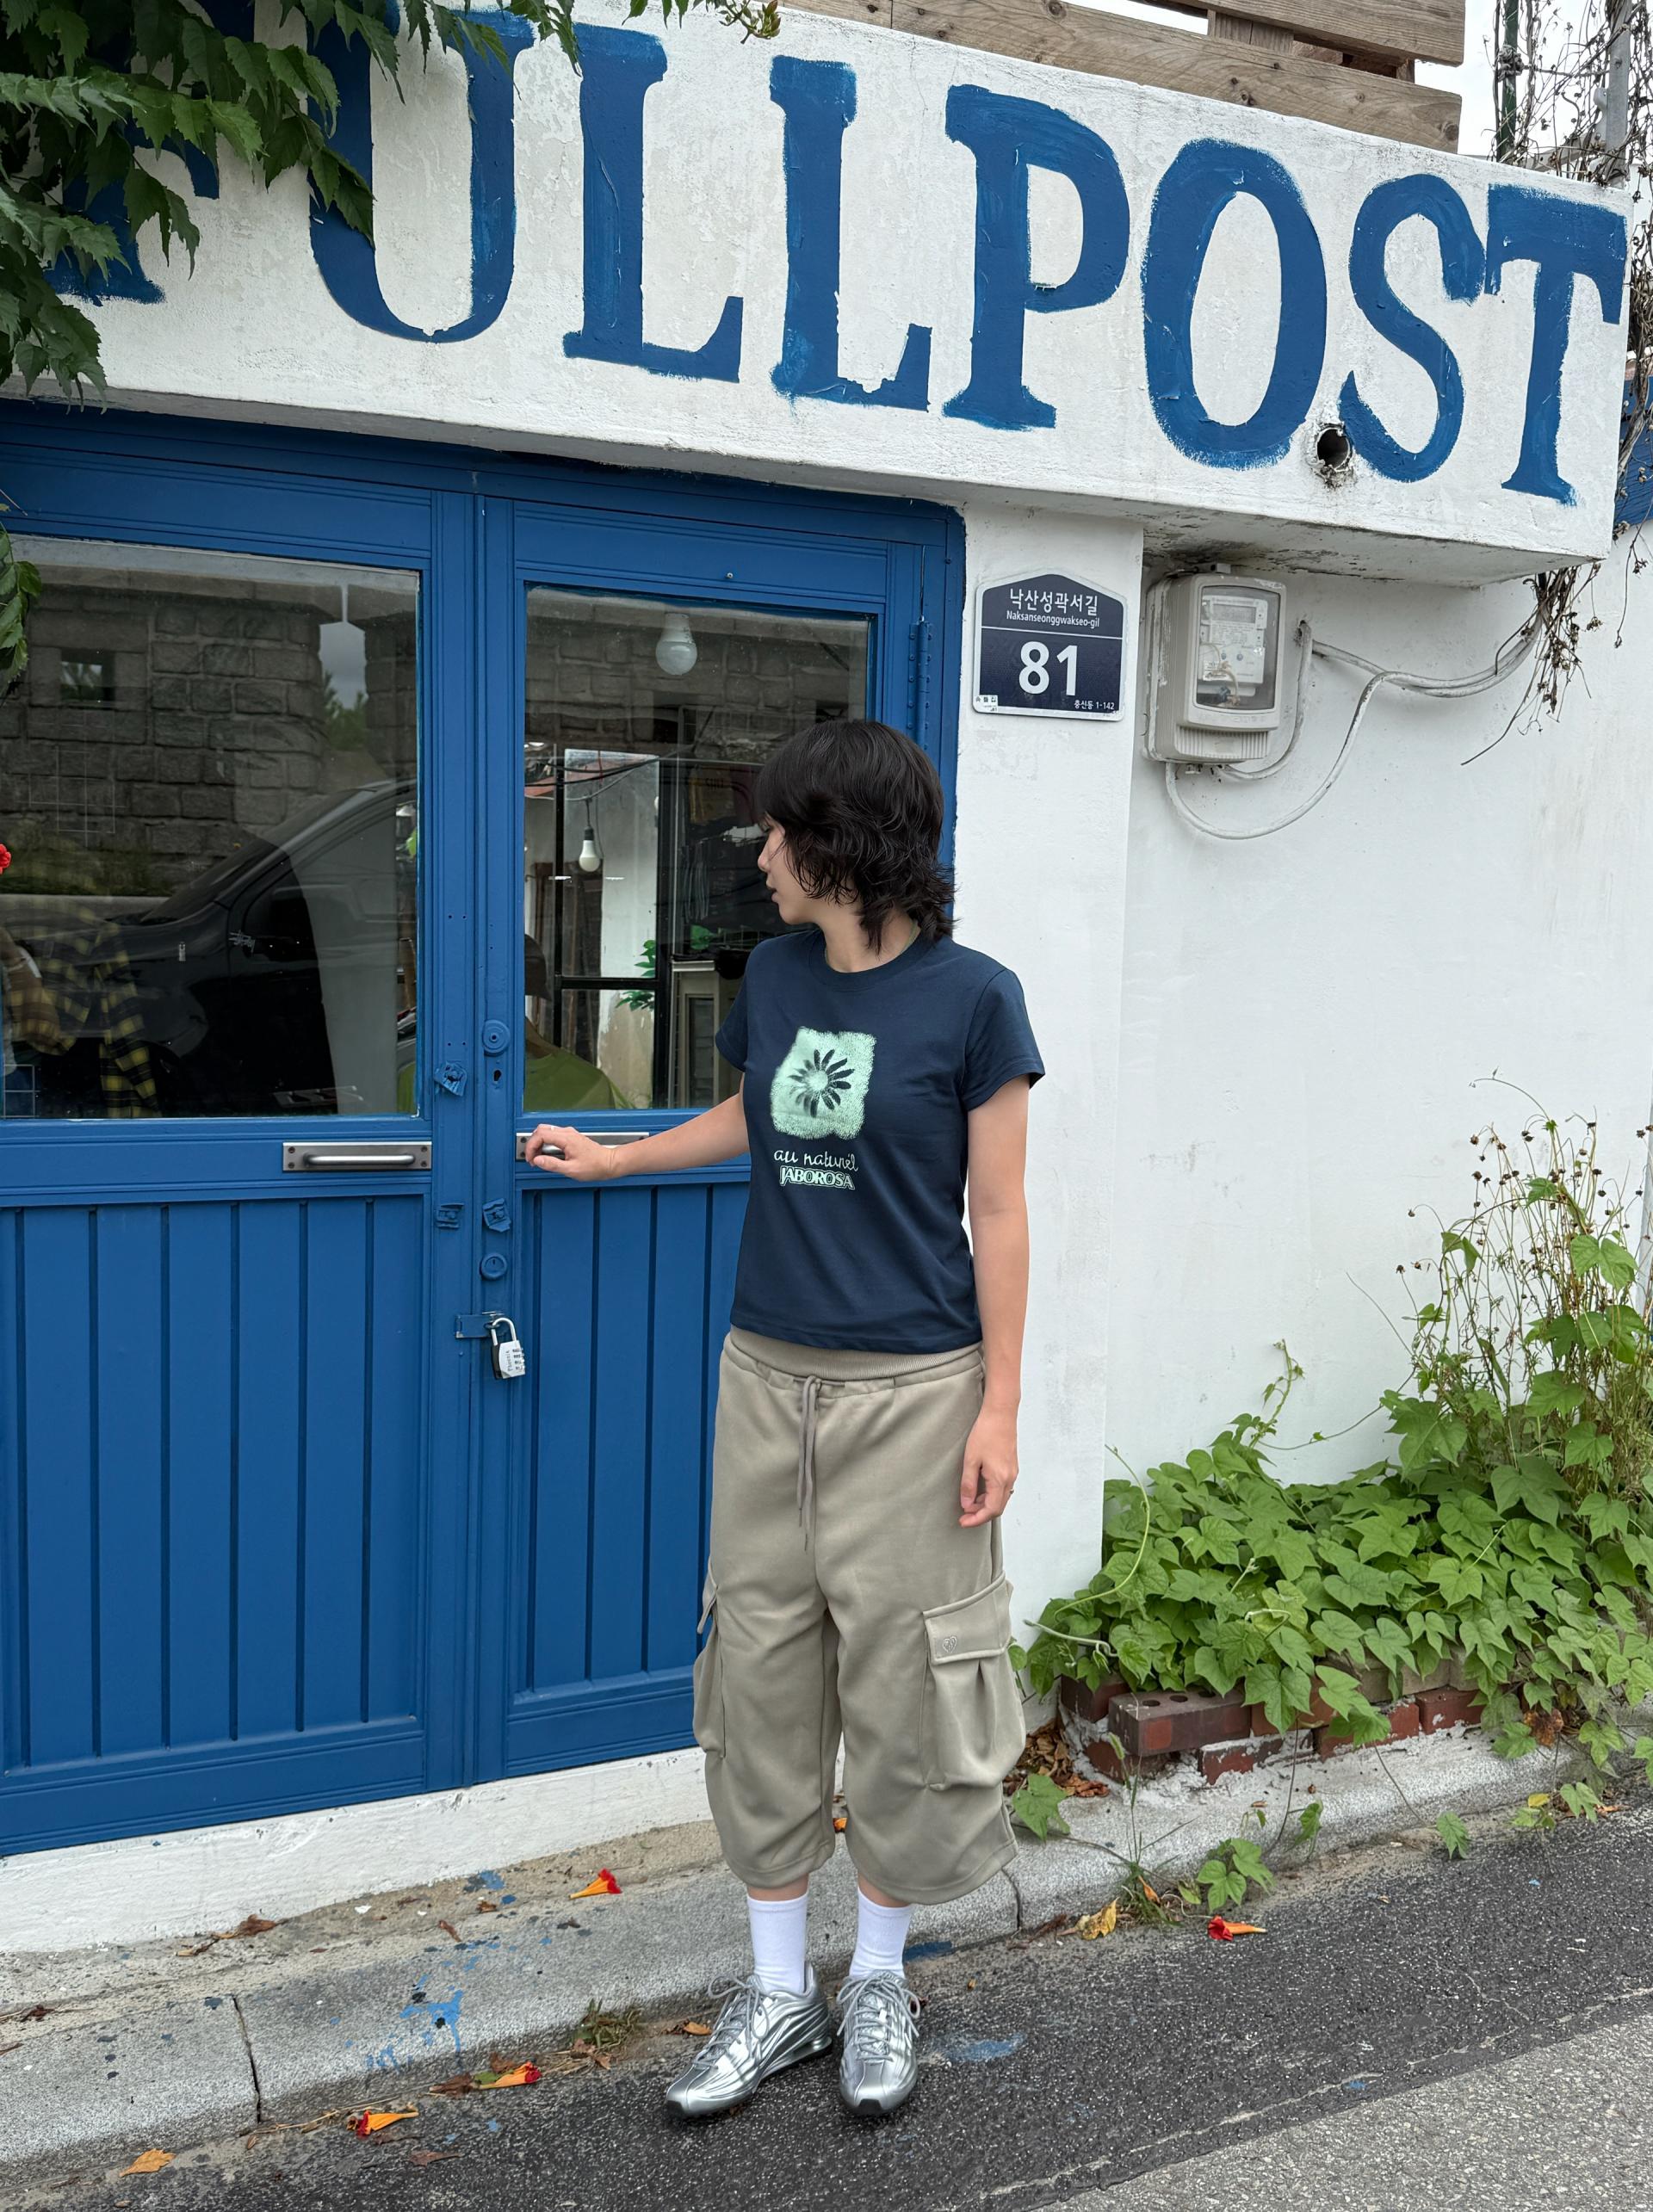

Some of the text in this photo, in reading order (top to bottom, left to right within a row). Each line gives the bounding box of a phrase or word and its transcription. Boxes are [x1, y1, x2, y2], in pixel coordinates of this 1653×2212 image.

[1009, 588, 1098, 616] 낙산성곽서길
[1006, 610, 1099, 629] Naksanseonggwakseo-gil
[1018, 640, 1078, 696] 81
[1095, 701, 1115, 710] 1-142
[774, 1150, 798, 1163] au
[779, 1165, 856, 1190] JABOROSA
